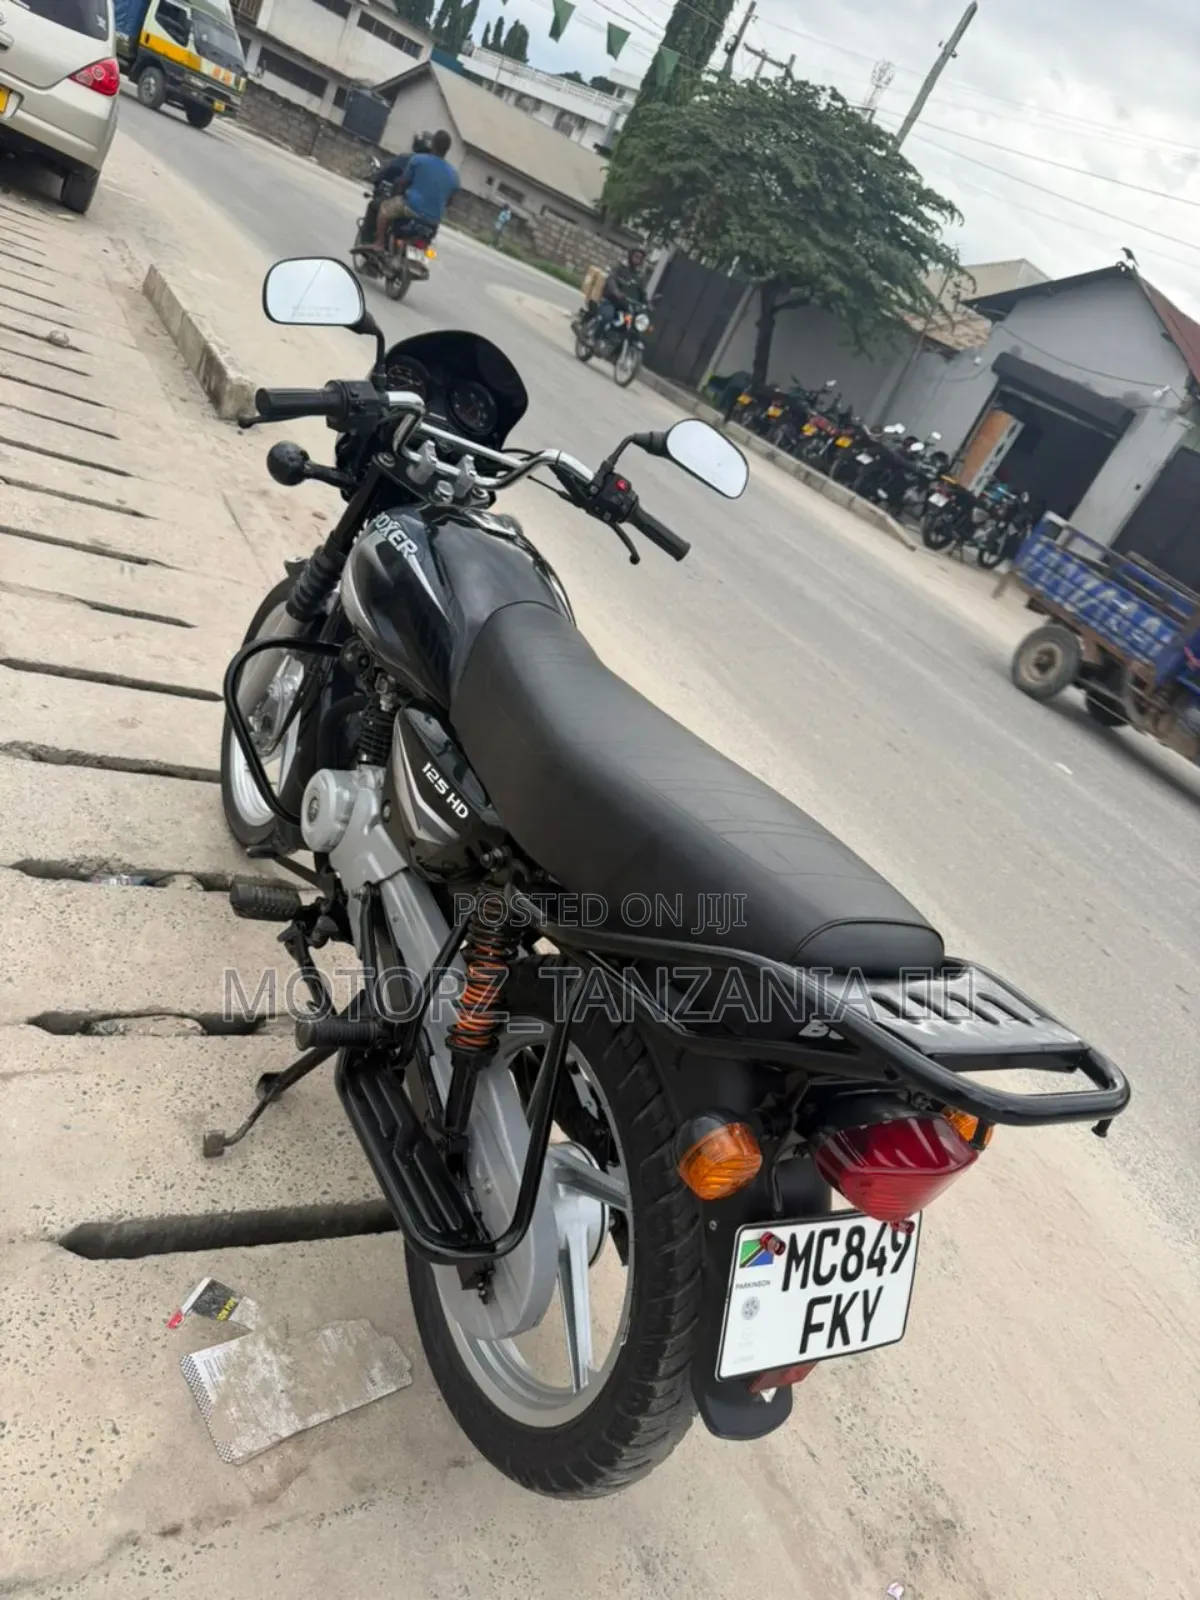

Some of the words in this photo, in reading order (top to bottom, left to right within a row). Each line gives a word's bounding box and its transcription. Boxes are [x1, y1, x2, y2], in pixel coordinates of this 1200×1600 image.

[421, 761, 450, 795] 125
[445, 792, 470, 819] HD
[735, 1279, 771, 1290] PARKINSON
[781, 1221, 913, 1292] MC849
[798, 1284, 884, 1355] FKY
